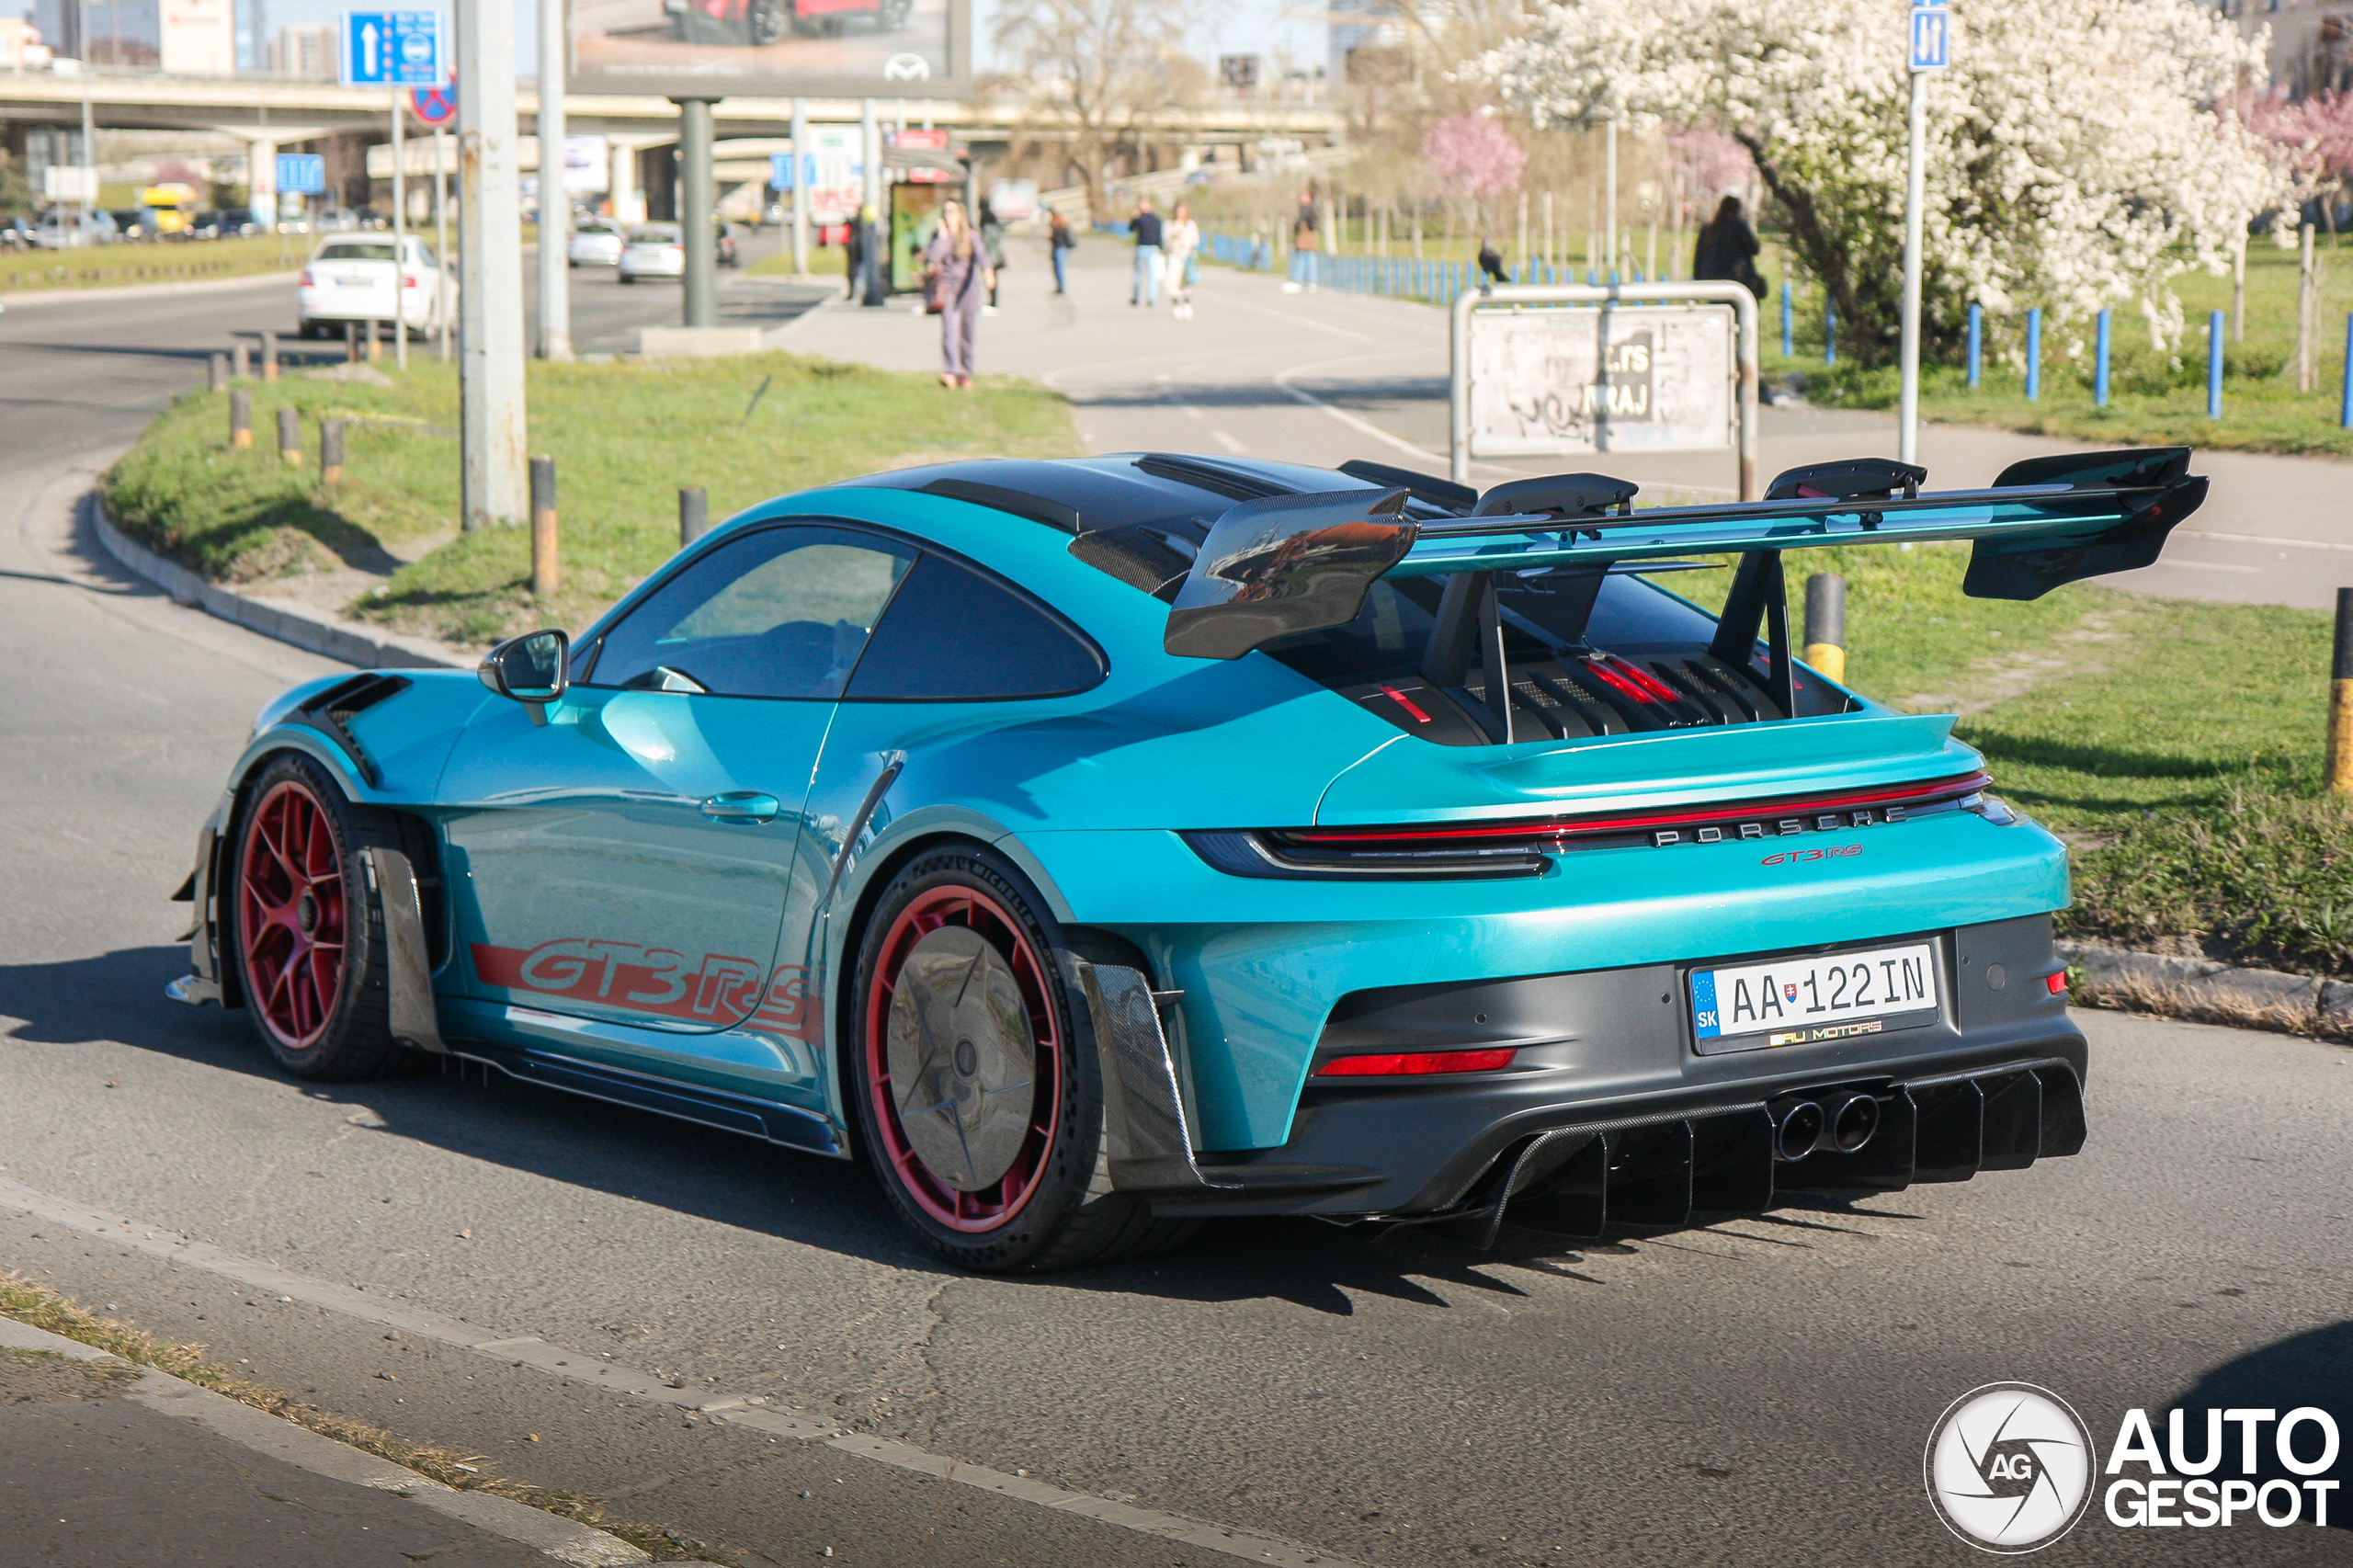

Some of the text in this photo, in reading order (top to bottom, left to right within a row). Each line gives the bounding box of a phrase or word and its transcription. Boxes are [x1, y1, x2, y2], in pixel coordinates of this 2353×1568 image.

[1653, 806, 1907, 847] PORSCHE
[1760, 843, 1864, 866] GT3RS
[972, 861, 1036, 928] MICHELIN
[1698, 1011, 1718, 1028] SK
[1813, 1020, 1883, 1040] MOTORS
